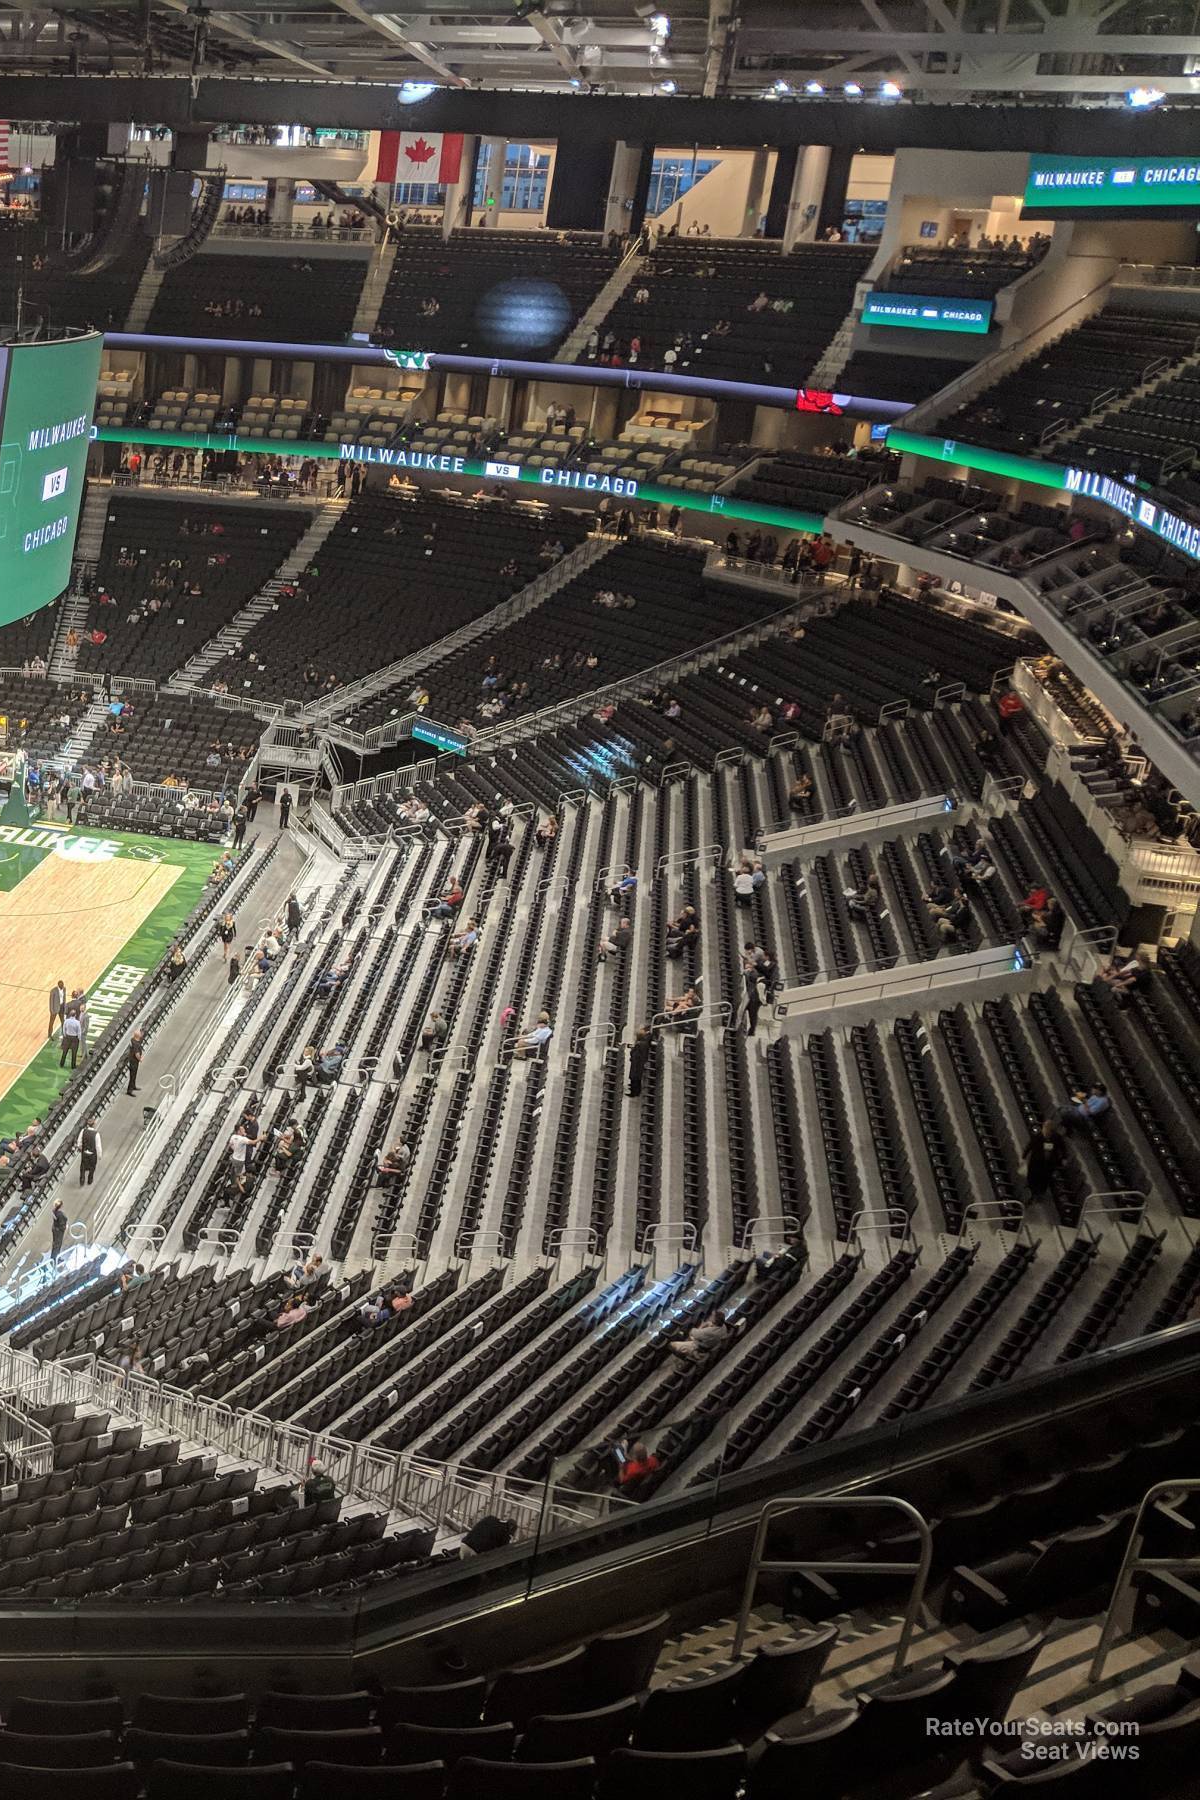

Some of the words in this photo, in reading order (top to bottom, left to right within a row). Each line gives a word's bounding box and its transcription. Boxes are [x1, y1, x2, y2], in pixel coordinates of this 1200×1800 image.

[1035, 171, 1104, 186] MILWAUKEE
[869, 305, 919, 316] MILWAUKEE
[943, 311, 982, 321] CHICAGO
[28, 413, 88, 451] MILWAUKEE
[51, 475, 61, 492] VS
[340, 443, 465, 473] MILWAUKEE
[496, 466, 510, 476] VS
[541, 468, 638, 497] CHICAGO
[1064, 469, 1136, 516] MILWAUKEE
[23, 516, 69, 552] CHICAGO
[98, 963, 149, 994] DEER
[86, 989, 129, 1013] THE
